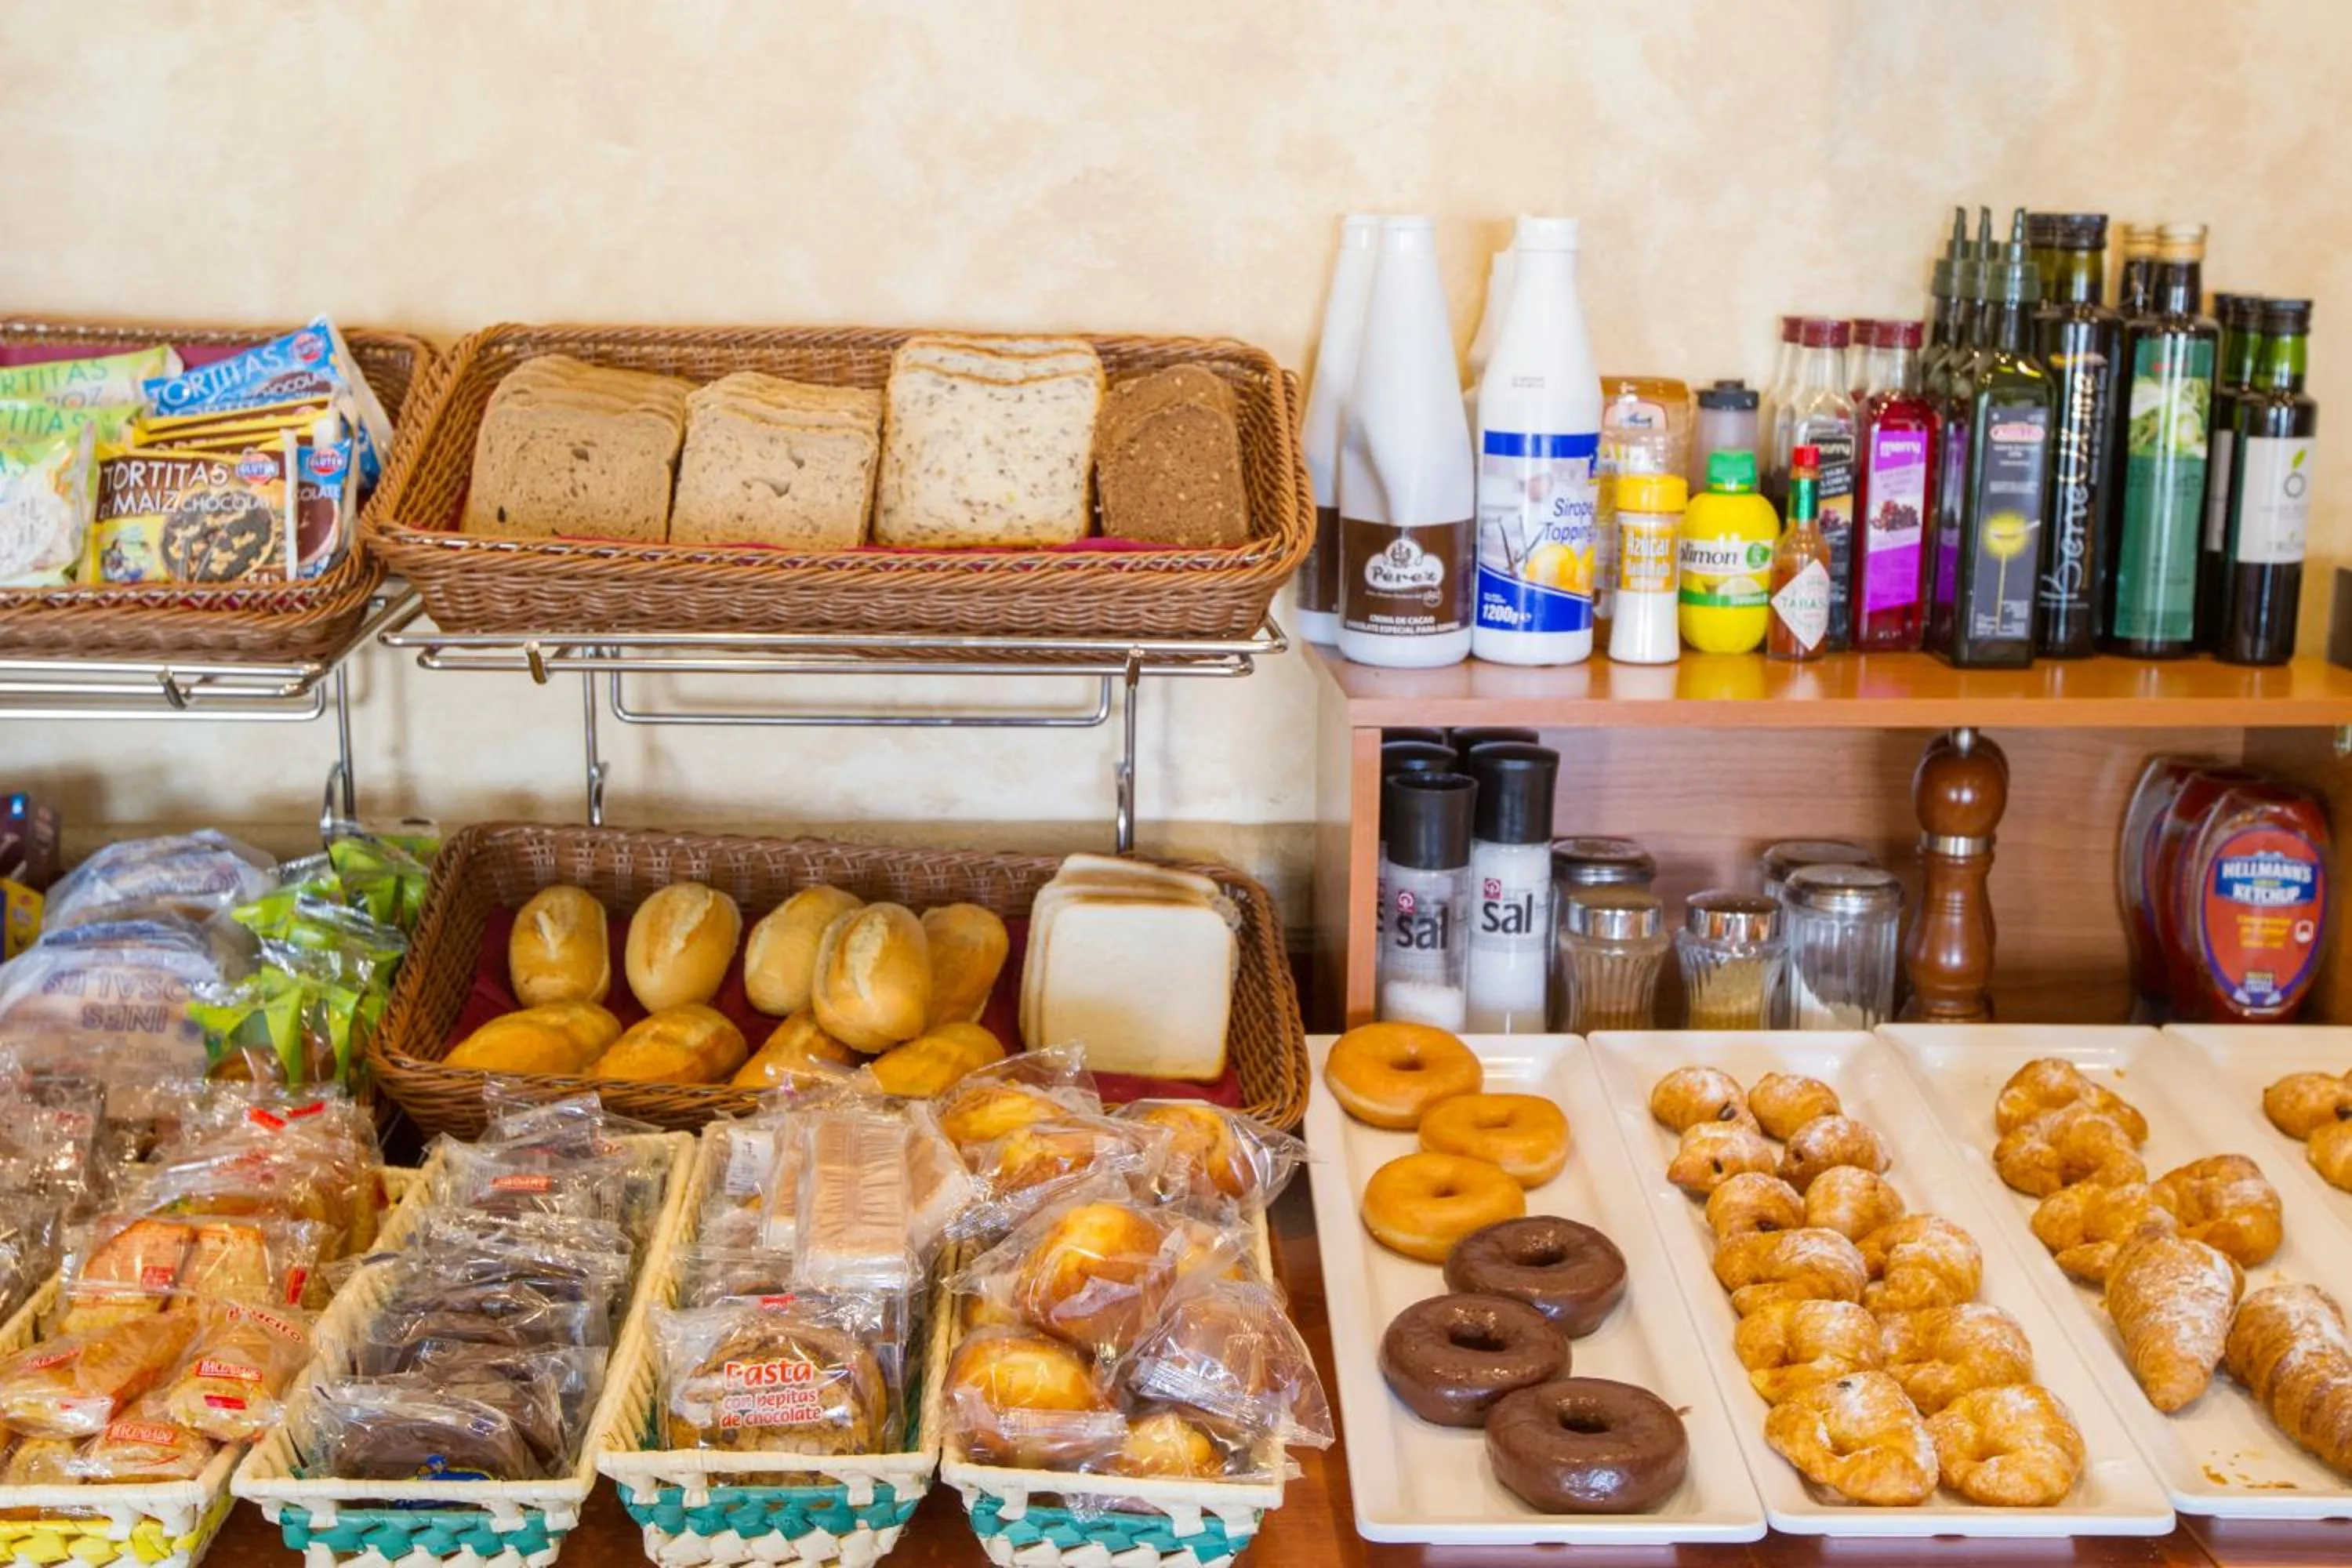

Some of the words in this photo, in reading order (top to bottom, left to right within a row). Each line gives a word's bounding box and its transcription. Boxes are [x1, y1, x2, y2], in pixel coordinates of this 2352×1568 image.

[104, 459, 228, 490] TORTITAS
[114, 489, 178, 514] MAIZ
[1396, 907, 1449, 950] sal
[1482, 895, 1533, 934] sal
[725, 1359, 814, 1388] Pasta
[757, 1388, 818, 1409] pepitas
[720, 1413, 742, 1428] de
[746, 1406, 822, 1426] chocolate
